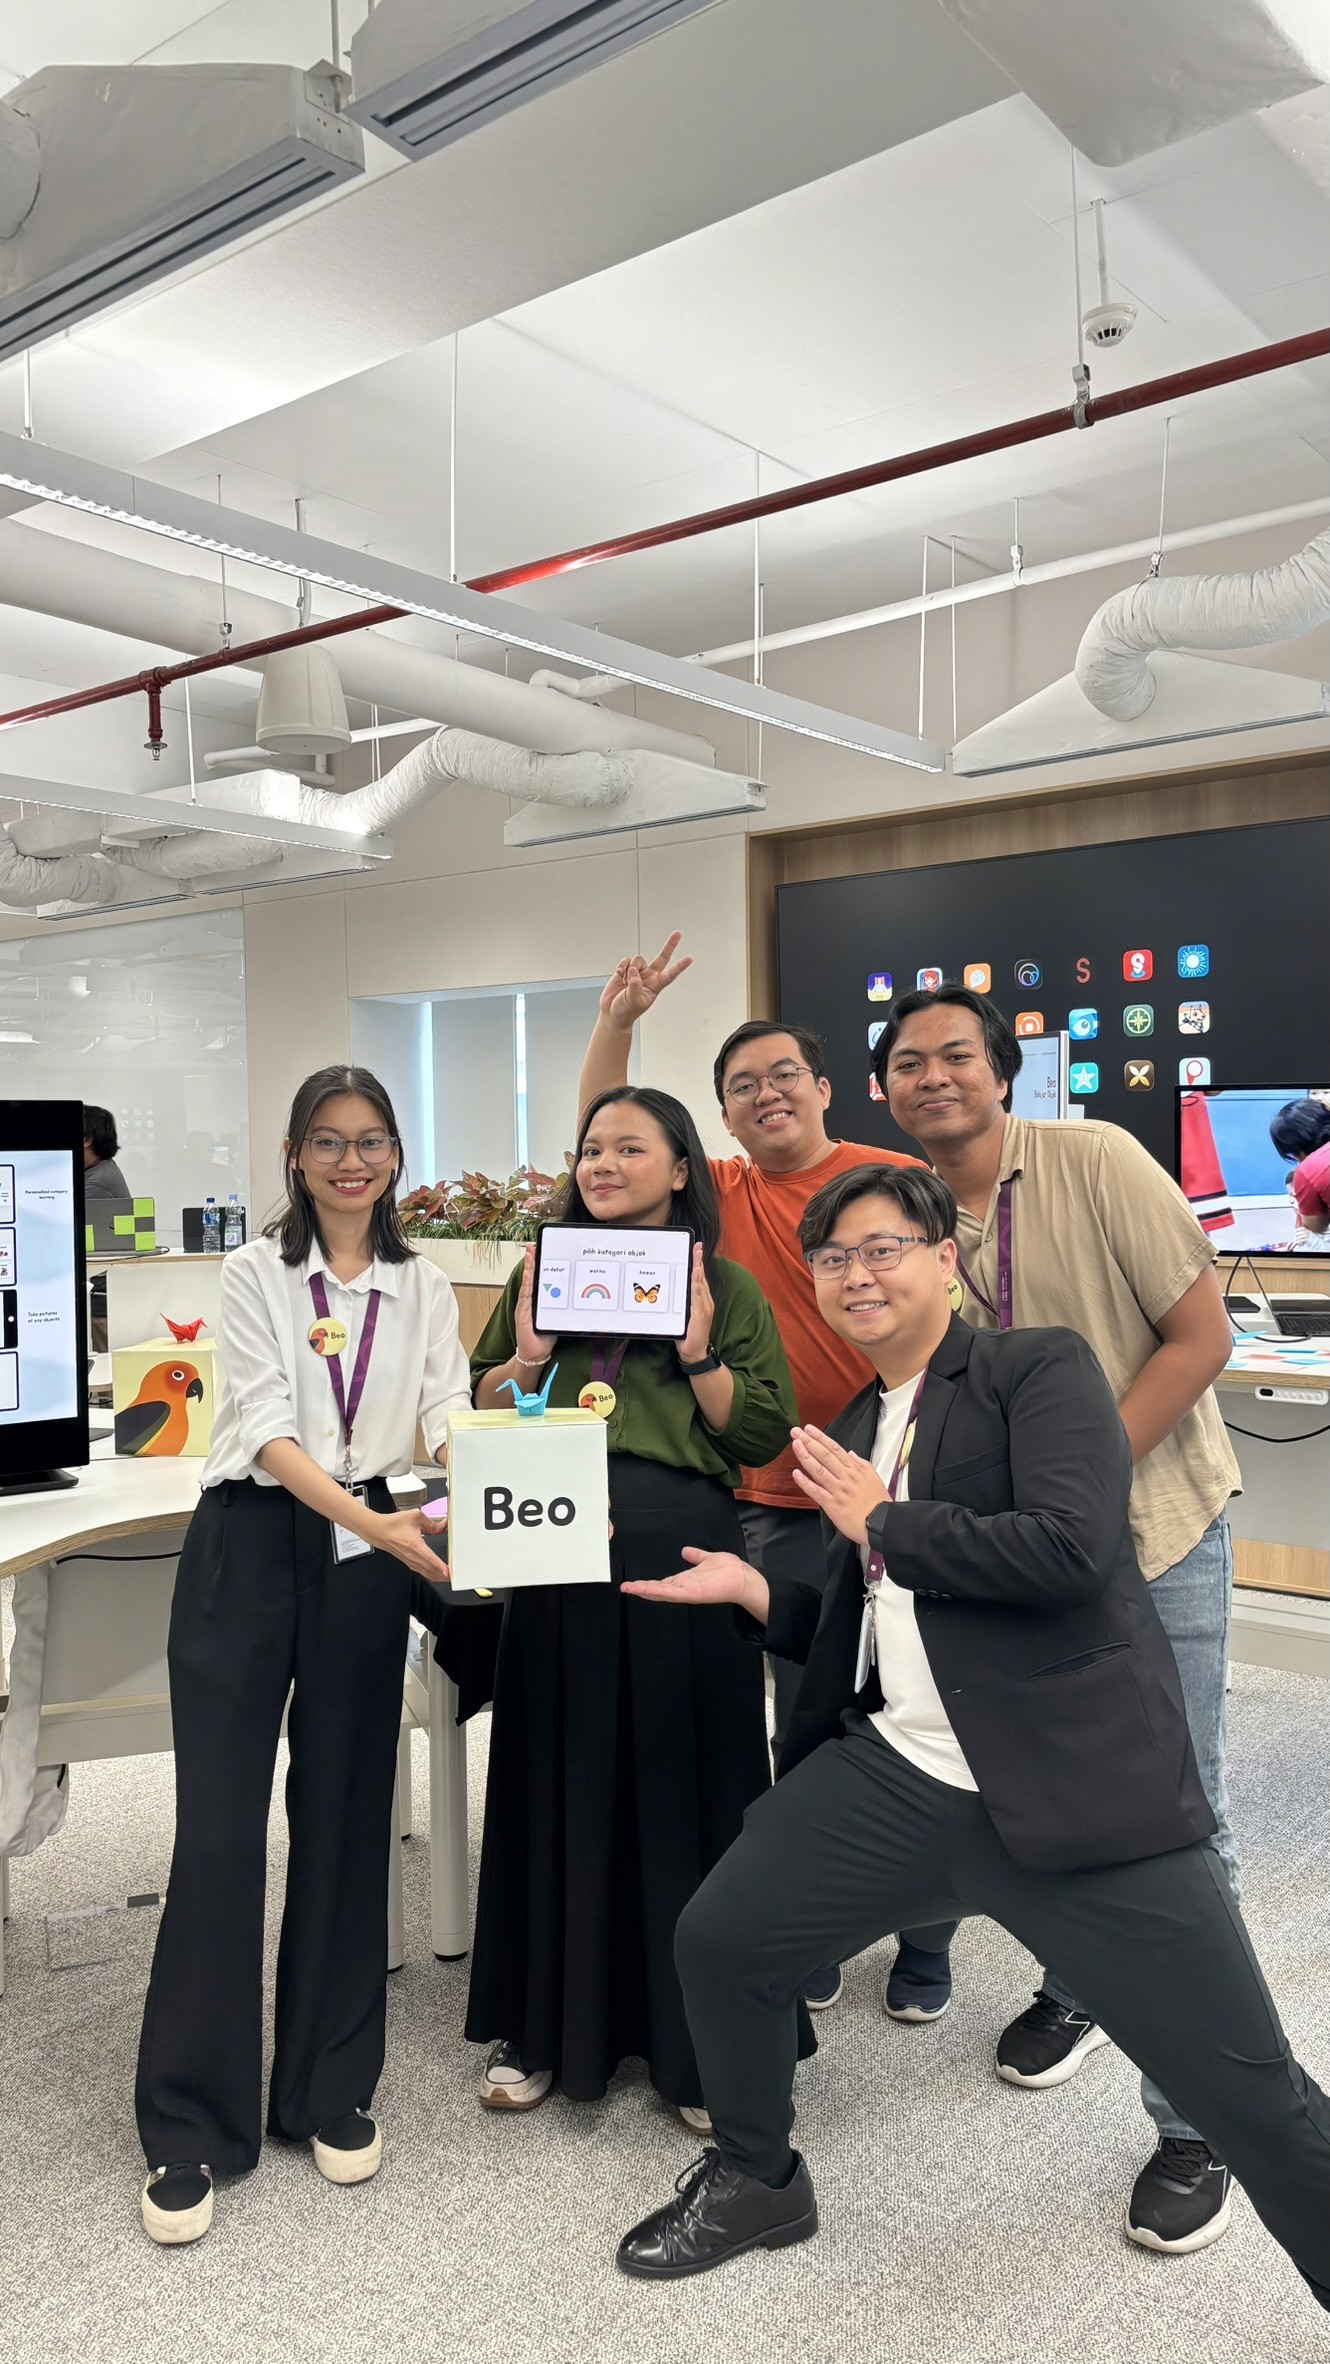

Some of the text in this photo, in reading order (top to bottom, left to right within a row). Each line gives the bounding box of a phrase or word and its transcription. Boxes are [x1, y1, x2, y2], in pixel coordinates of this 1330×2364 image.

[1047, 1076, 1056, 1088] Beo
[598, 1249, 626, 1257] kategori
[331, 1331, 346, 1340] Beo
[598, 1394, 613, 1402] Beo
[484, 1486, 576, 1530] Beo
